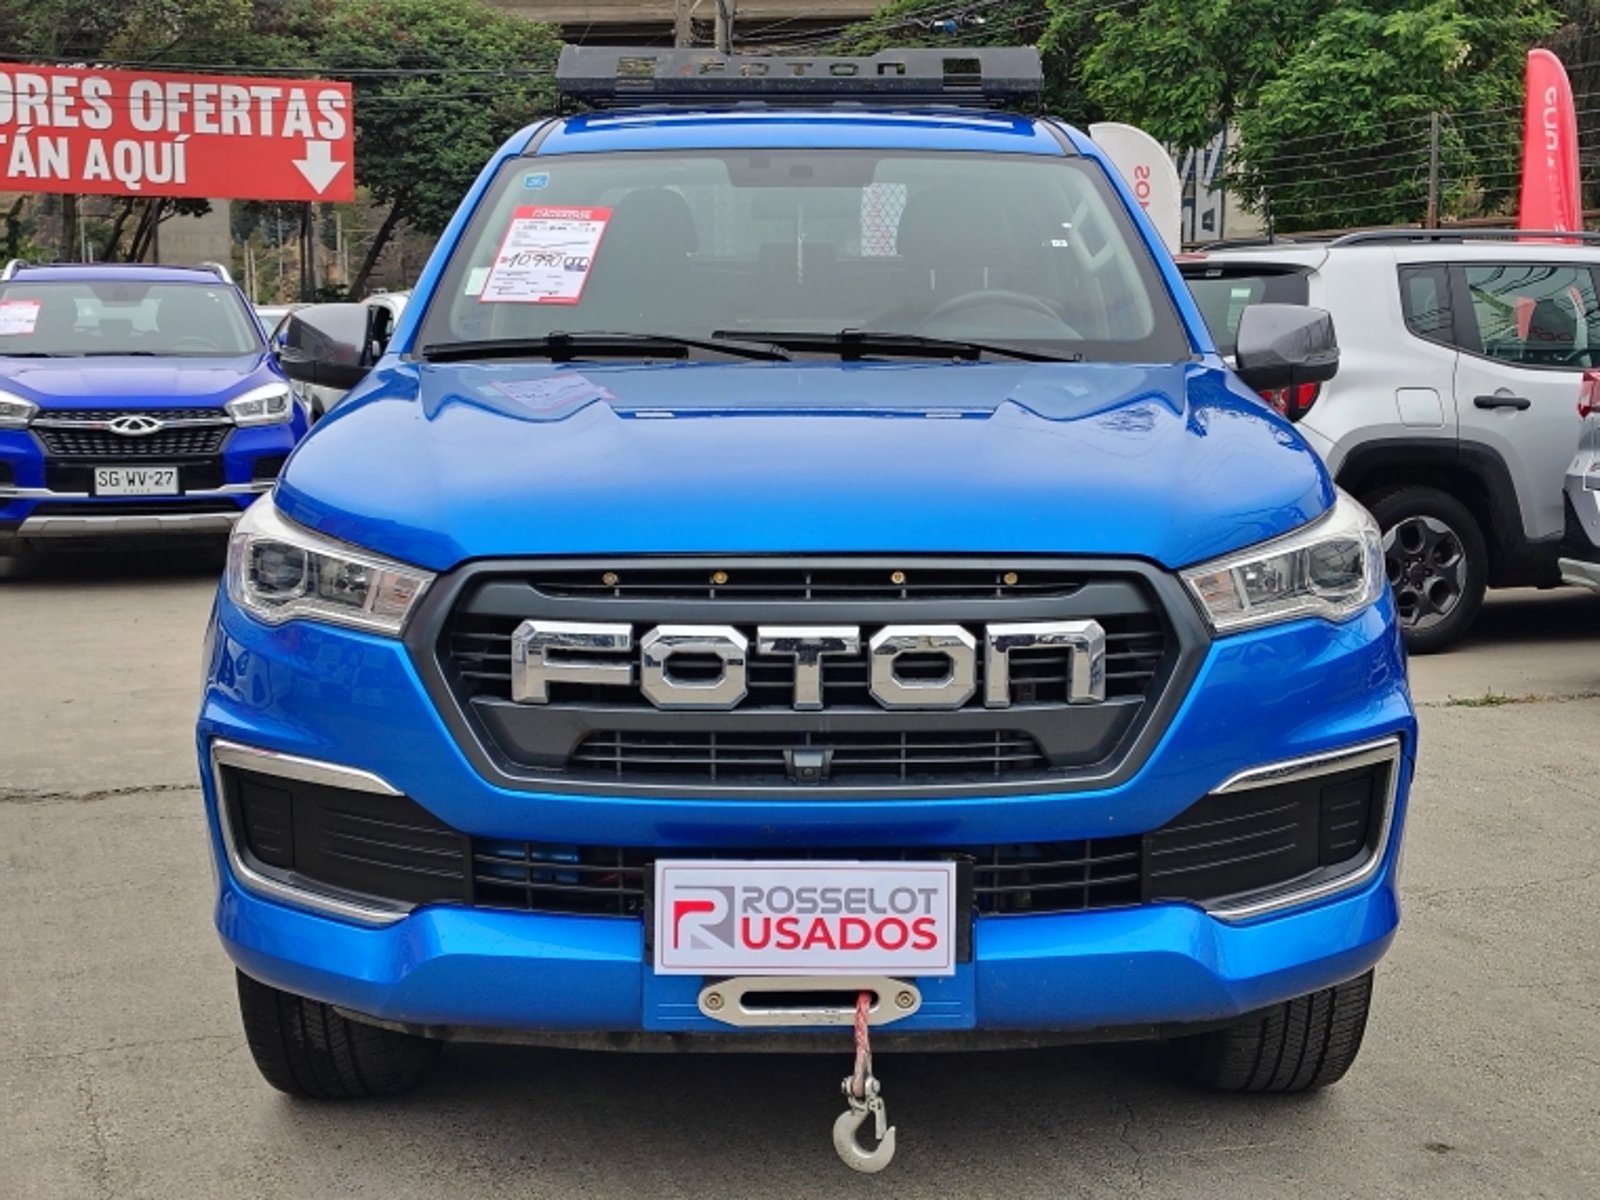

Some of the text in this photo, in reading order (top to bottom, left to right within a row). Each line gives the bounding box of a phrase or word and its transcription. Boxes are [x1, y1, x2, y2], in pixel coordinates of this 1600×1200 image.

[699, 61, 907, 76] FOTON
[129, 79, 347, 141] OFERTAS
[0, 126, 190, 190] ÁN AQUÍ
[510, 618, 1106, 710] FOTON
[741, 886, 938, 915] ROSSELOT
[741, 916, 938, 951] USADOS
